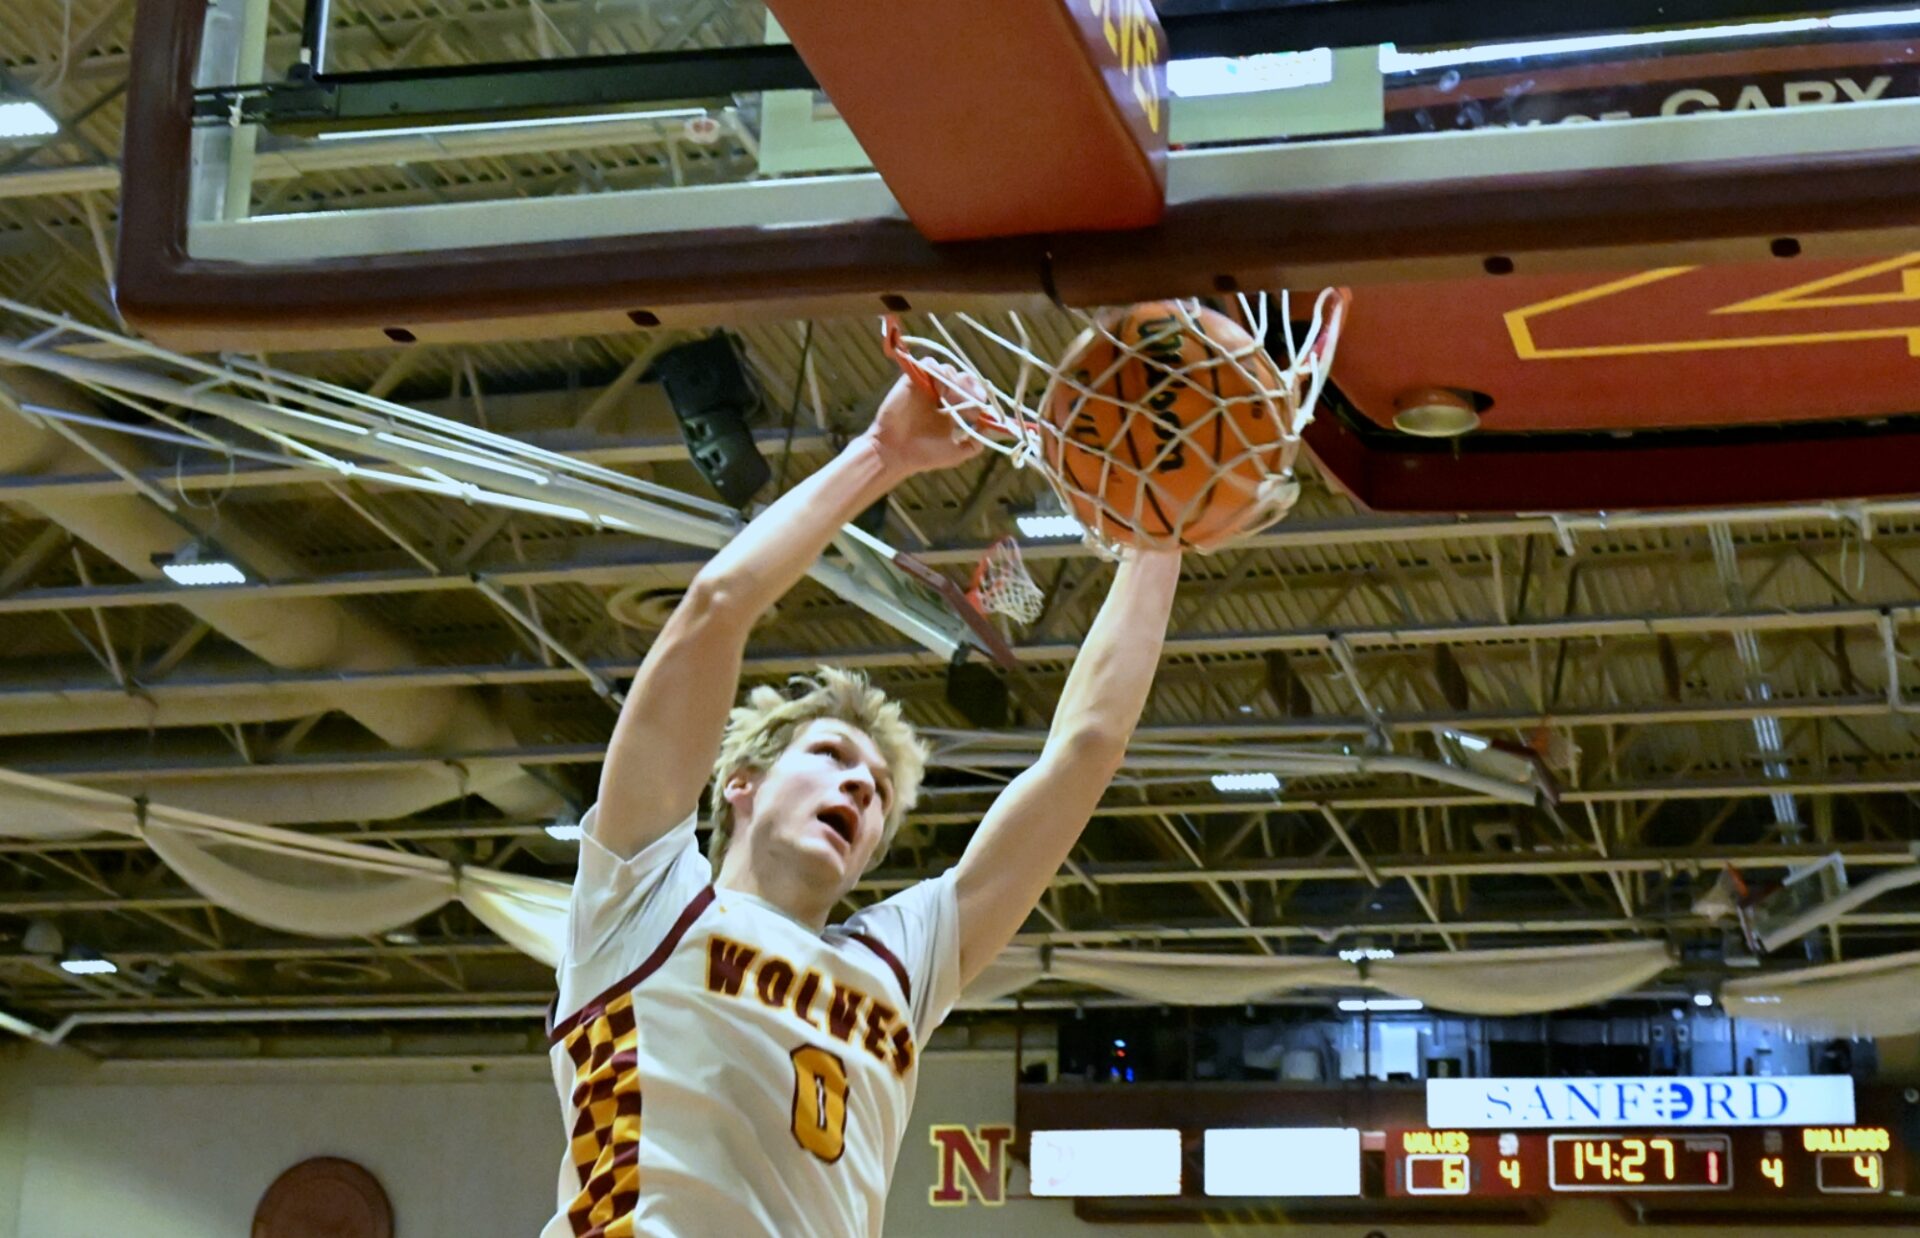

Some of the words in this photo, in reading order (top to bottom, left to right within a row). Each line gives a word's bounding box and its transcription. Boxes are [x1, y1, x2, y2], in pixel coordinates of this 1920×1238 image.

[705, 934, 914, 1079] WOLVES
[789, 1042, 849, 1164] 0
[1486, 1081, 1789, 1121] SANFORD
[930, 1124, 1012, 1207] N
[1442, 1157, 1466, 1190] 6
[1498, 1160, 1520, 1189] 4
[1574, 1139, 1675, 1182] 14:27
[1707, 1151, 1719, 1184] 1
[1761, 1158, 1784, 1188] 4
[1854, 1155, 1880, 1189] 4
